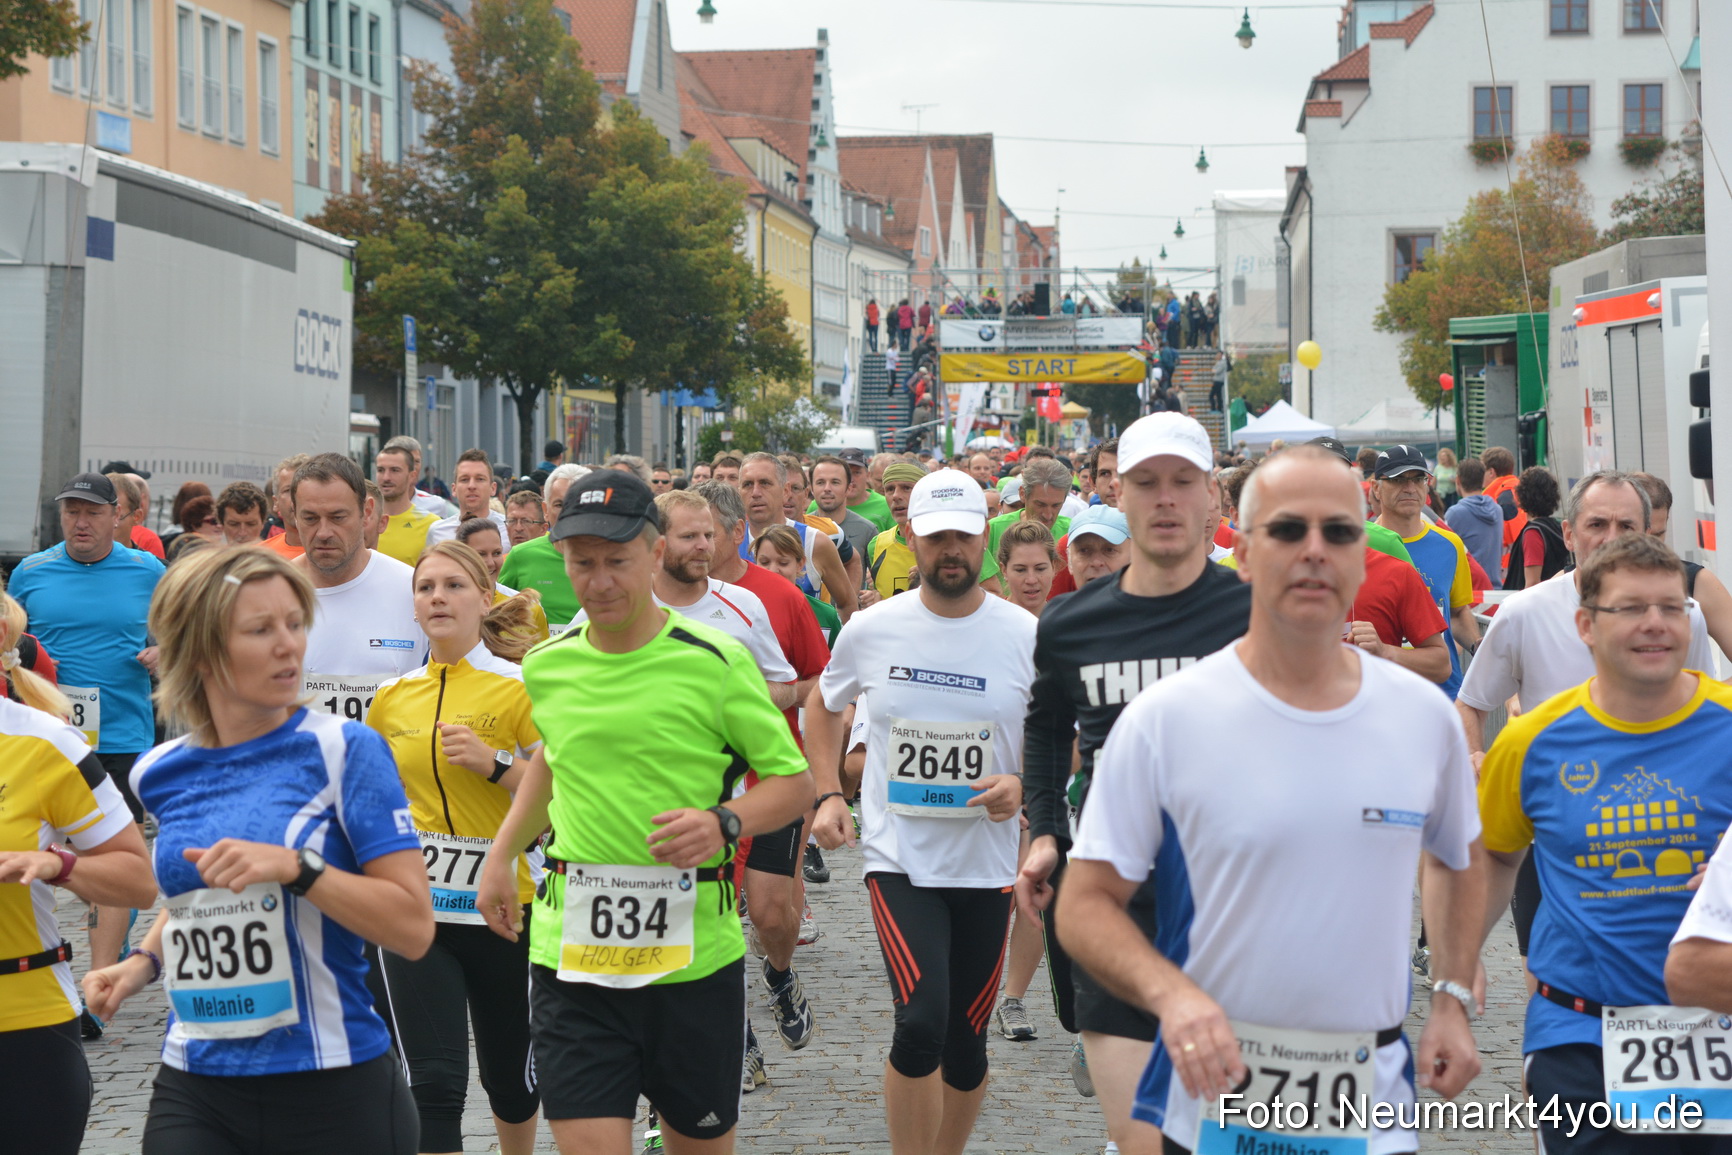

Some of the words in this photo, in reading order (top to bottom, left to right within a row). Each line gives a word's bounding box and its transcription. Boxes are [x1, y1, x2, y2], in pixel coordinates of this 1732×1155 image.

[294, 308, 342, 380] BOCK
[1007, 359, 1078, 376] START
[306, 682, 337, 691] PARTL
[339, 684, 379, 692] Neumark
[916, 671, 982, 689] BÜSCHEL
[324, 696, 374, 723] 19
[892, 726, 923, 739] PARTL
[925, 731, 975, 741] Neumarkt
[897, 743, 984, 780] 2649
[1568, 773, 1591, 782] Jahre
[922, 789, 954, 804] Jens
[418, 830, 448, 841] PARTL
[1589, 836, 1666, 851] 21.September
[1669, 833, 1697, 844] 2014
[423, 844, 486, 886] 277
[569, 875, 608, 888] PARTL
[611, 877, 673, 890] Neumarkt
[1579, 883, 1688, 898] www.stadtlauf-neum
[431, 891, 475, 910] hristia
[590, 895, 668, 940] 634
[172, 921, 273, 980] 2936
[580, 945, 663, 967] HOLGER
[192, 994, 255, 1017] Melanie
[1607, 1019, 1655, 1031] PARTL
[1236, 1038, 1266, 1056] RTL
[1271, 1044, 1349, 1062] Neumarkt
[1620, 1036, 1732, 1084] 2815
